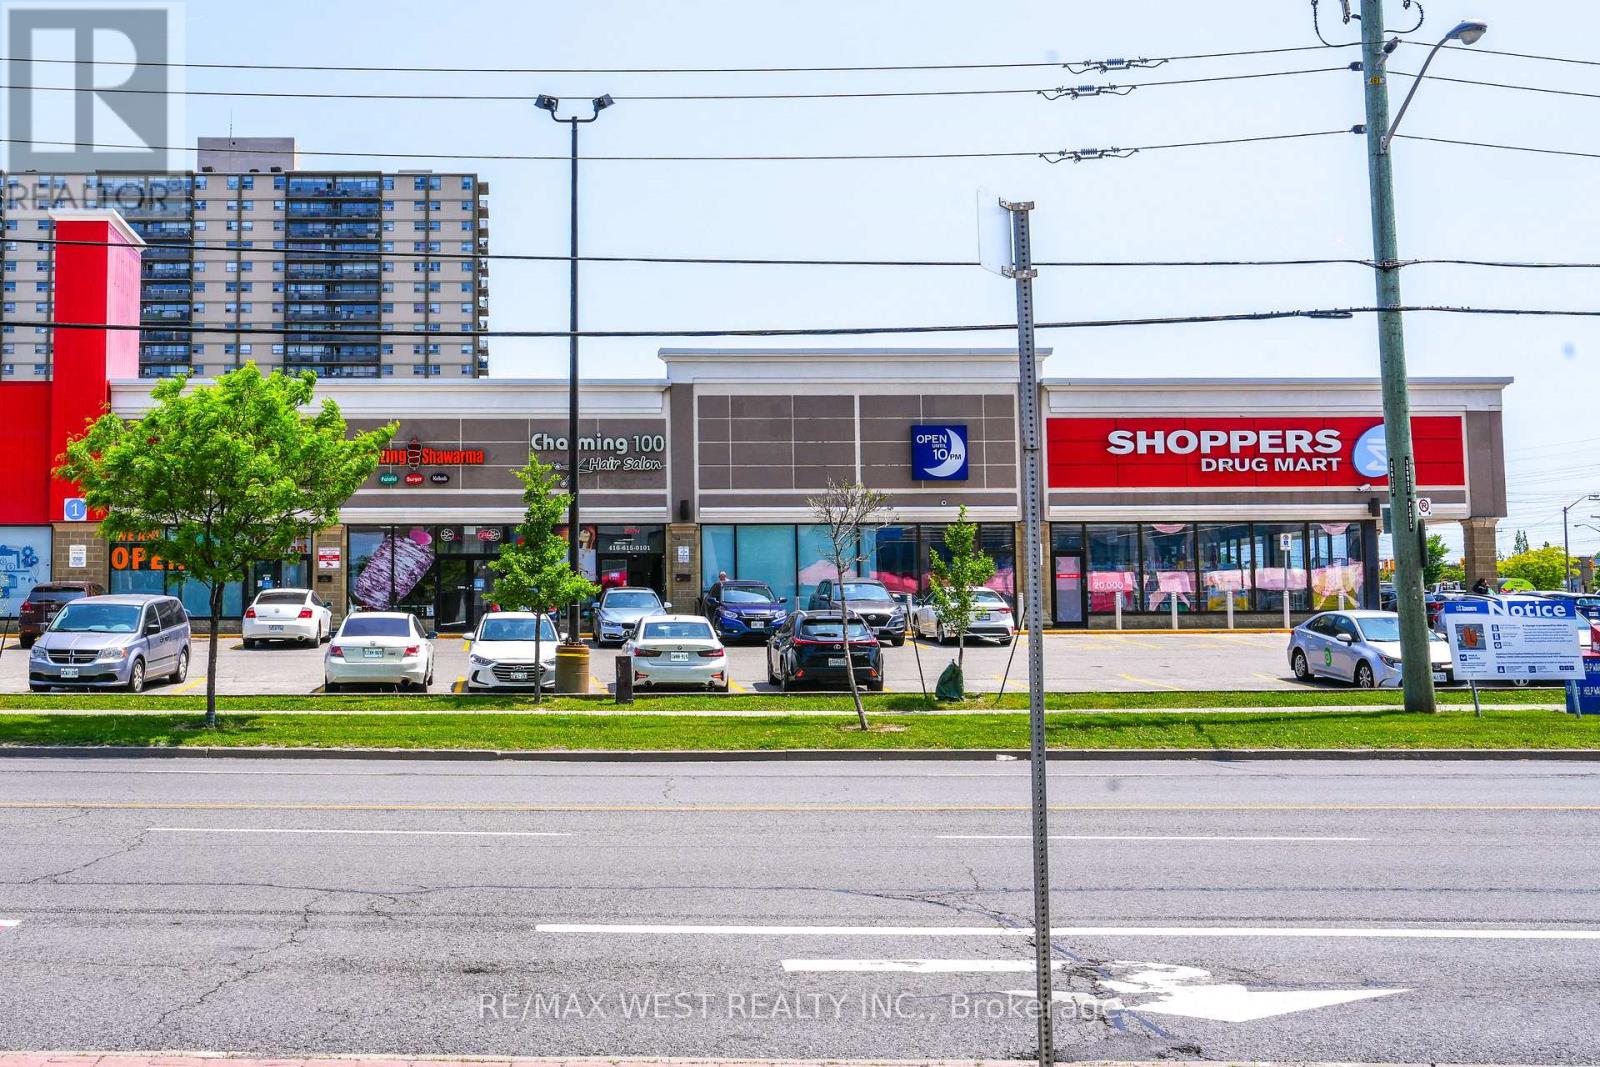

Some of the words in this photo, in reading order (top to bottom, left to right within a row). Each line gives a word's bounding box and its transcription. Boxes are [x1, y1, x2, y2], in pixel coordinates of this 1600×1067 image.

[531, 432, 628, 455] Chaming
[632, 435, 665, 452] 100
[916, 434, 947, 444] OPEN
[1106, 429, 1342, 455] SHOPPERS
[377, 448, 407, 466] zing
[422, 447, 485, 465] Shawarma
[933, 449, 948, 460] 10
[589, 456, 621, 471] Hair
[623, 456, 662, 471] Salon
[1201, 457, 1268, 473] DRUG
[1274, 456, 1342, 472] MART
[71, 502, 80, 517] 1
[111, 546, 186, 571] OPE
[1488, 600, 1566, 618] Notice
